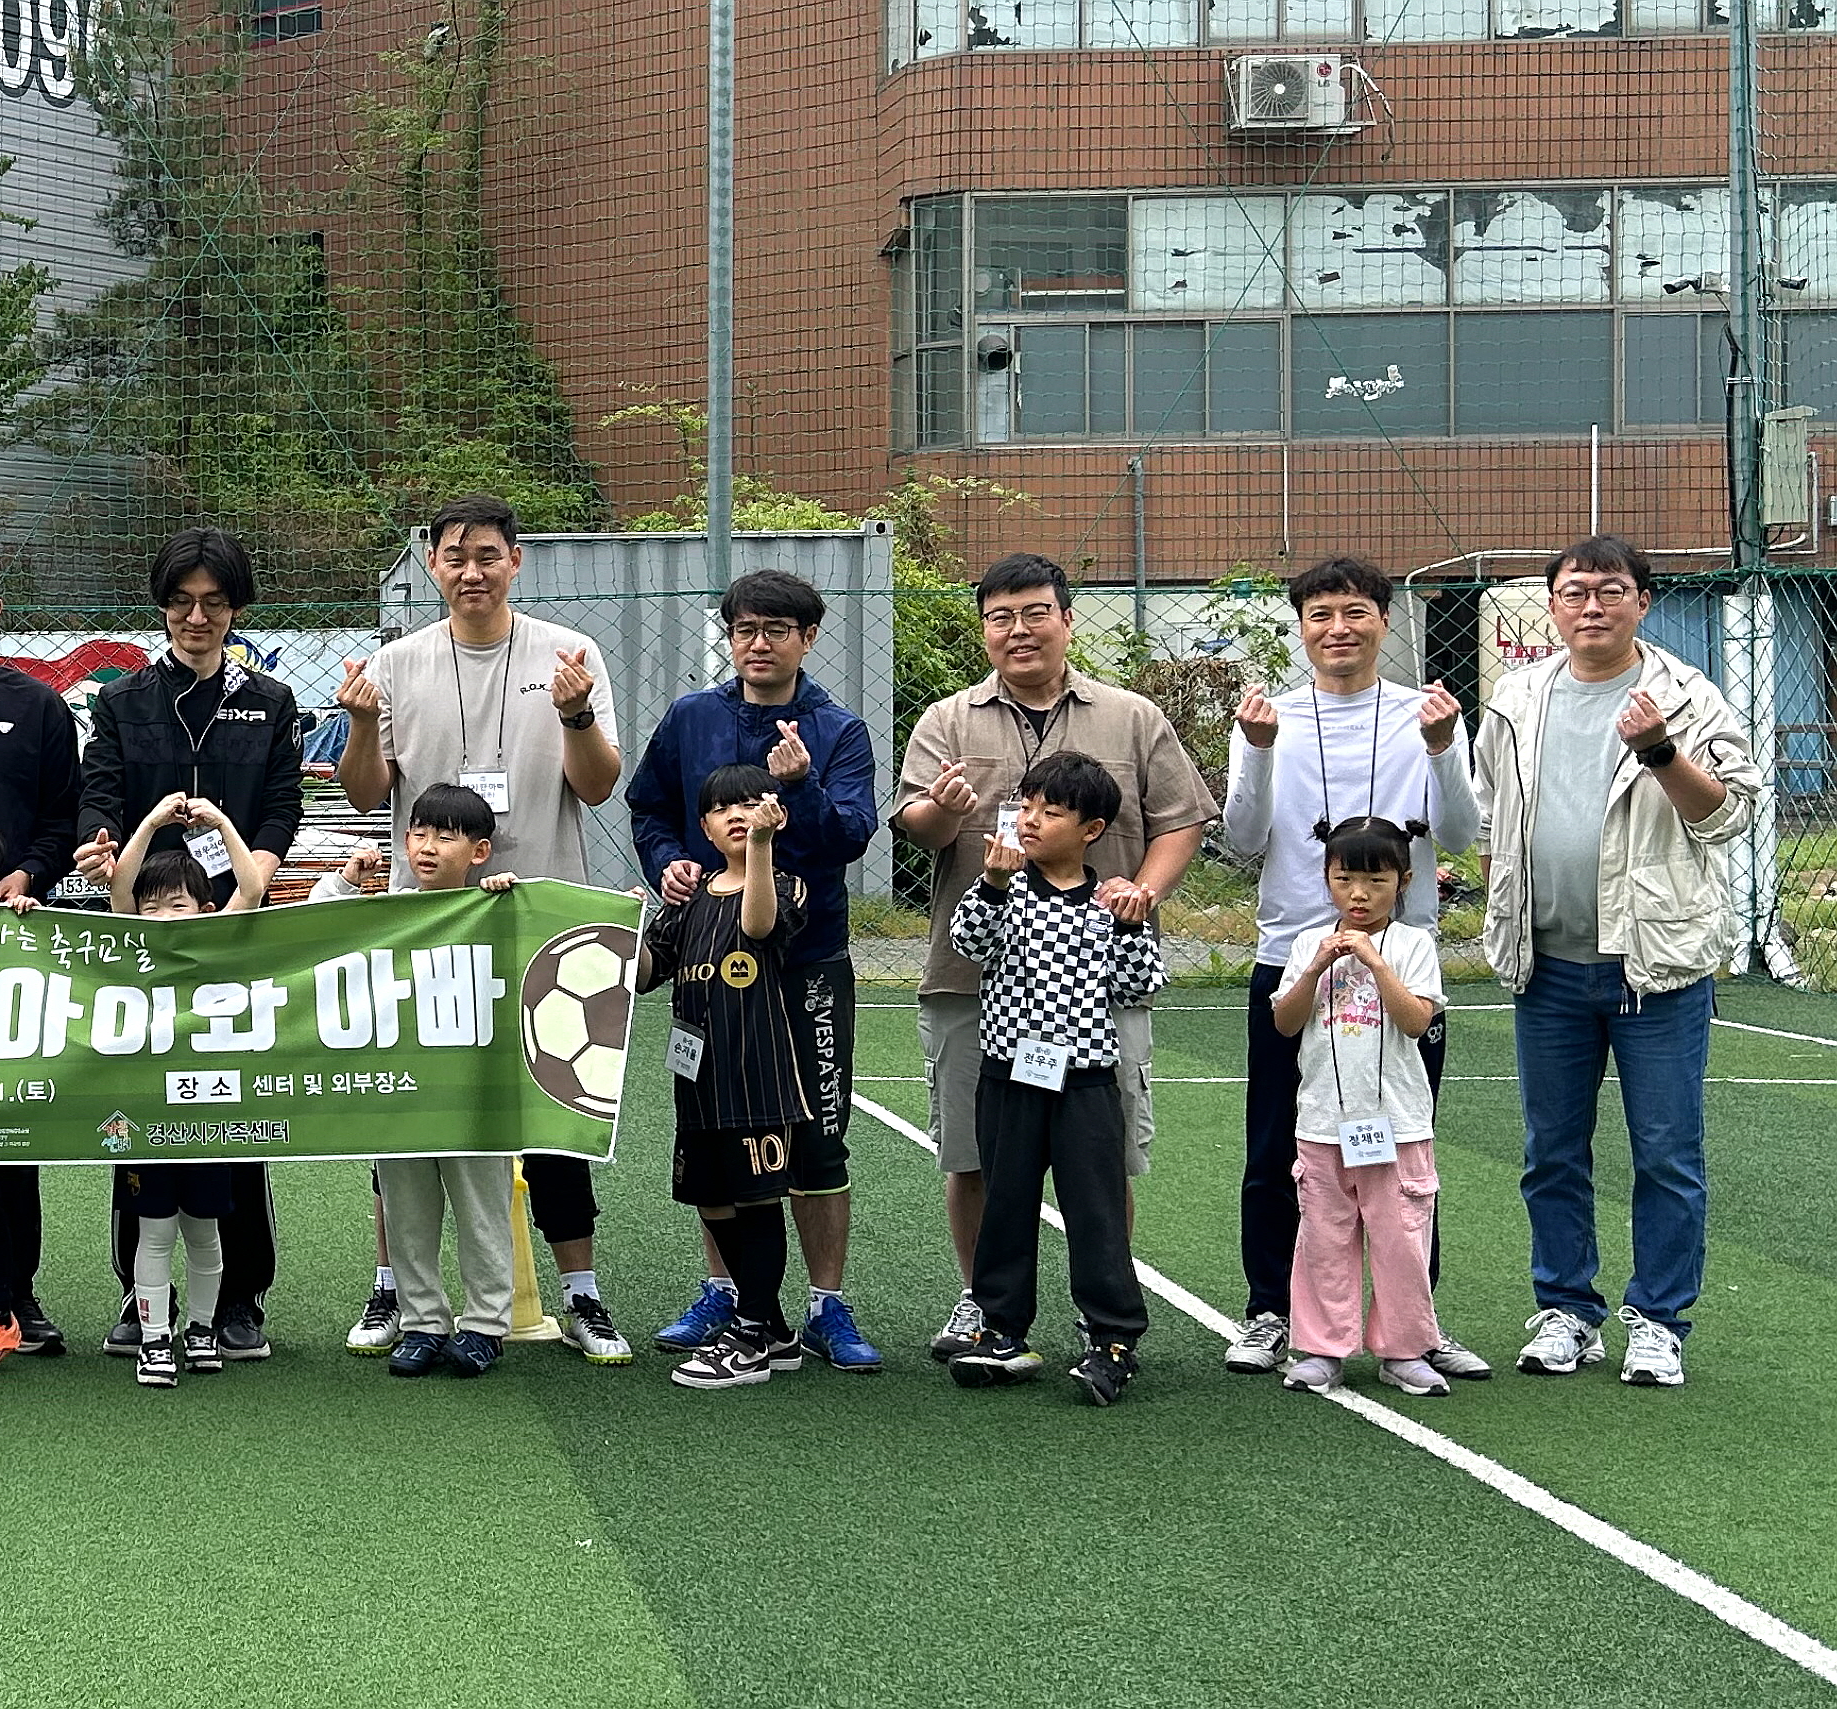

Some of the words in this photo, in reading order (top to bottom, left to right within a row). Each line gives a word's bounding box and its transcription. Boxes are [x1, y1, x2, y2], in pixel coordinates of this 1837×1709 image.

[49, 923, 157, 973] 축구교실
[312, 943, 507, 1050] 아빠
[814, 1009, 835, 1077] VESPA
[252, 1073, 295, 1097] 센터
[303, 1072, 323, 1097] 및
[330, 1071, 419, 1095] 외부장소
[819, 1080, 839, 1137] STYLE
[146, 1119, 290, 1146] 경산시가족센터
[742, 1133, 785, 1176] 10
